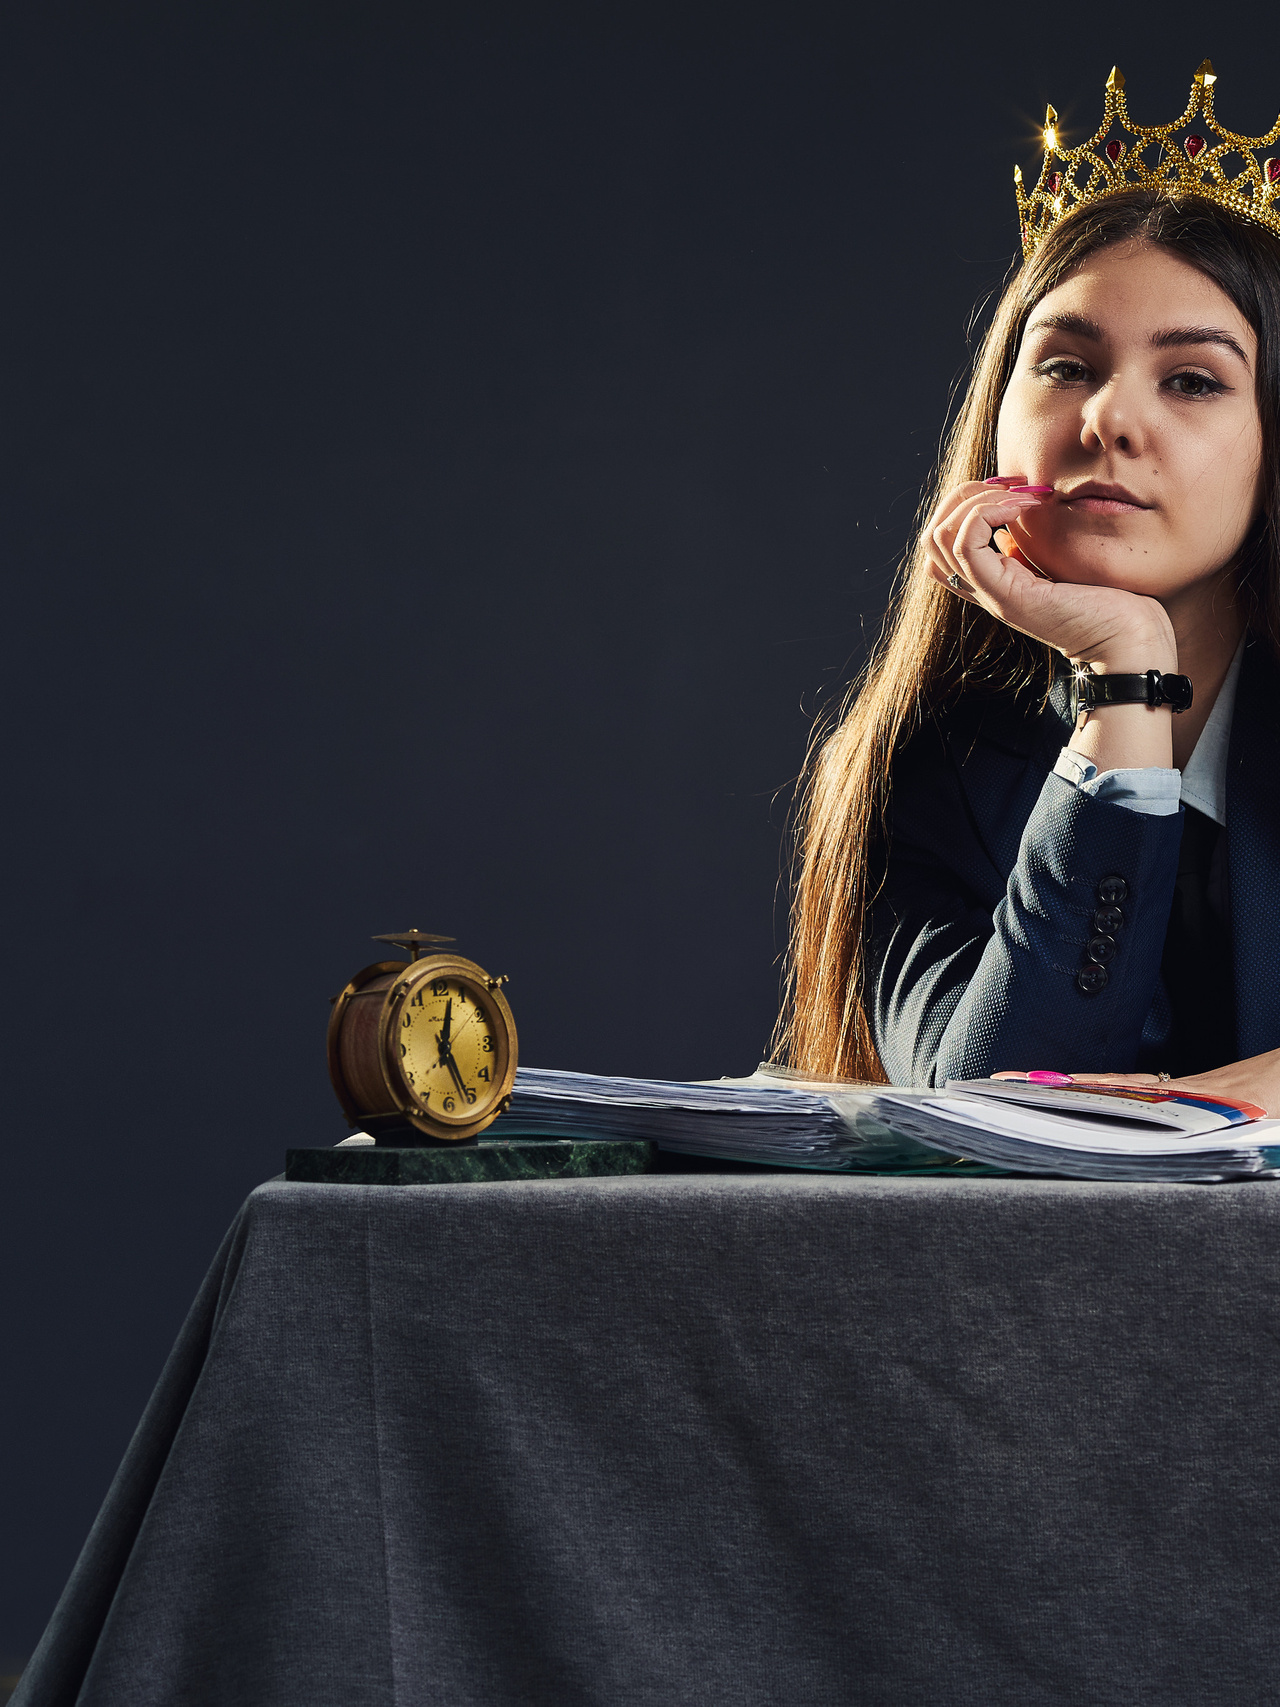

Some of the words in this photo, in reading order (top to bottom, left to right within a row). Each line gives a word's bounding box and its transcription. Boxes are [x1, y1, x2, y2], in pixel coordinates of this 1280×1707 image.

[431, 980, 449, 997] 12
[457, 986, 466, 1003] 1
[474, 1006, 486, 1023] 2
[482, 1035, 494, 1052] 3
[477, 1066, 490, 1082] 4
[443, 1096, 455, 1112] 6
[466, 1088, 477, 1104] 5
